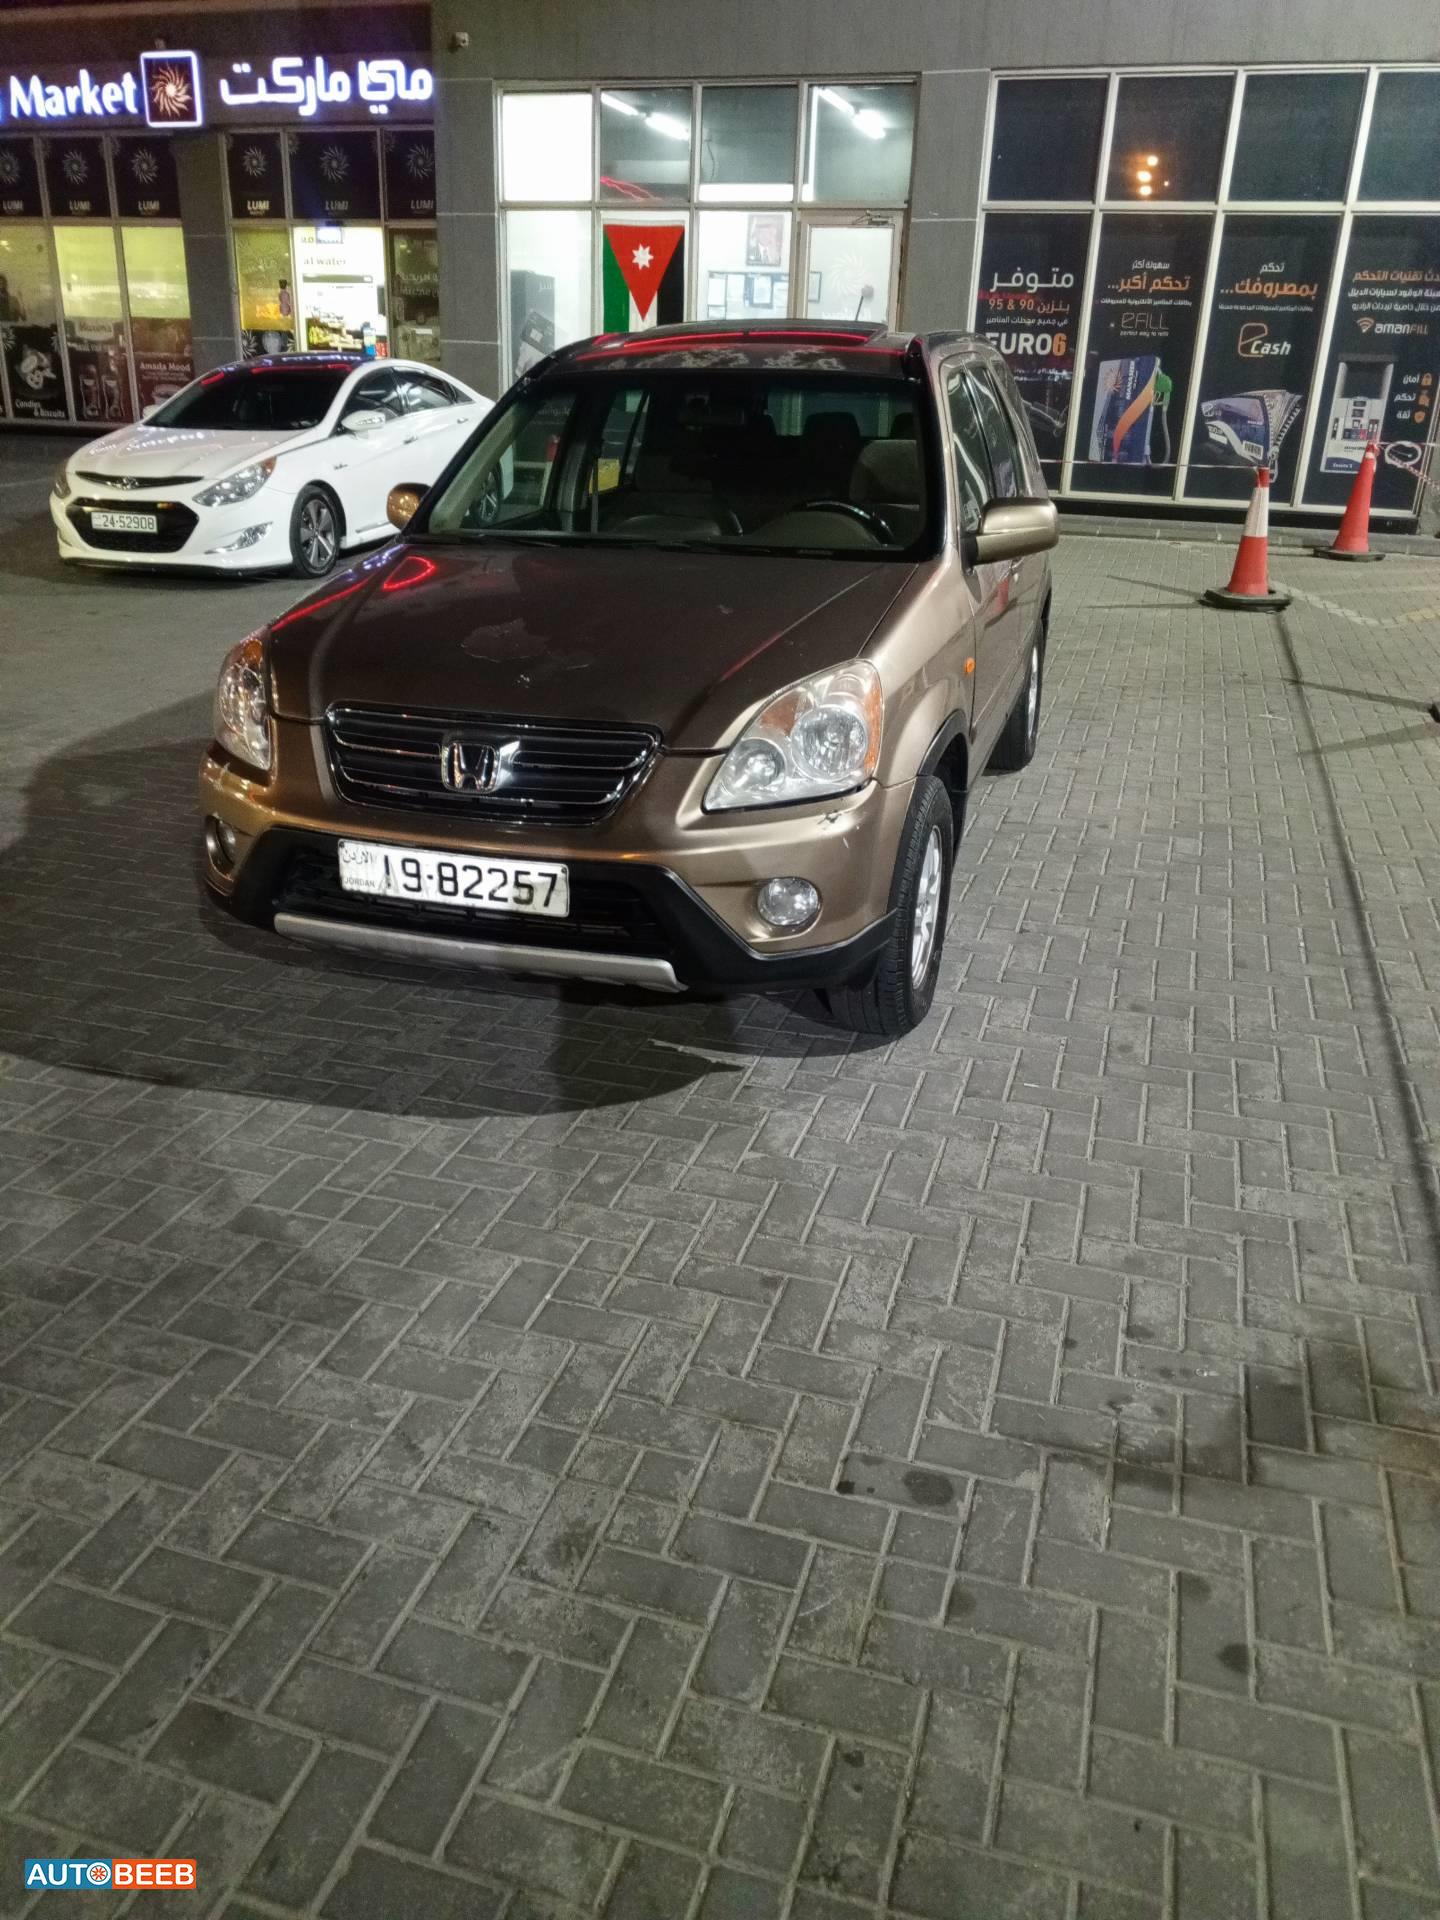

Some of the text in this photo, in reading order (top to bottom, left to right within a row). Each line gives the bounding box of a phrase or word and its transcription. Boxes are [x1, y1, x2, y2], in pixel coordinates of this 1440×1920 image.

[219, 56, 351, 116] ماركت
[10, 68, 139, 118] Market
[247, 200, 270, 211] LUMI
[325, 200, 348, 211] LUMI
[410, 199, 434, 209] LUMI
[1259, 262, 1286, 275] تحكم
[989, 266, 1075, 293] متوفر
[1352, 270, 1389, 283] التحكم
[1148, 275, 1191, 293] تحكم
[988, 299, 1071, 314] بنزين 90 & 95
[985, 332, 1068, 356] EURO6
[1393, 392, 1416, 403] تحكم
[345, 877, 376, 888] JORDAN
